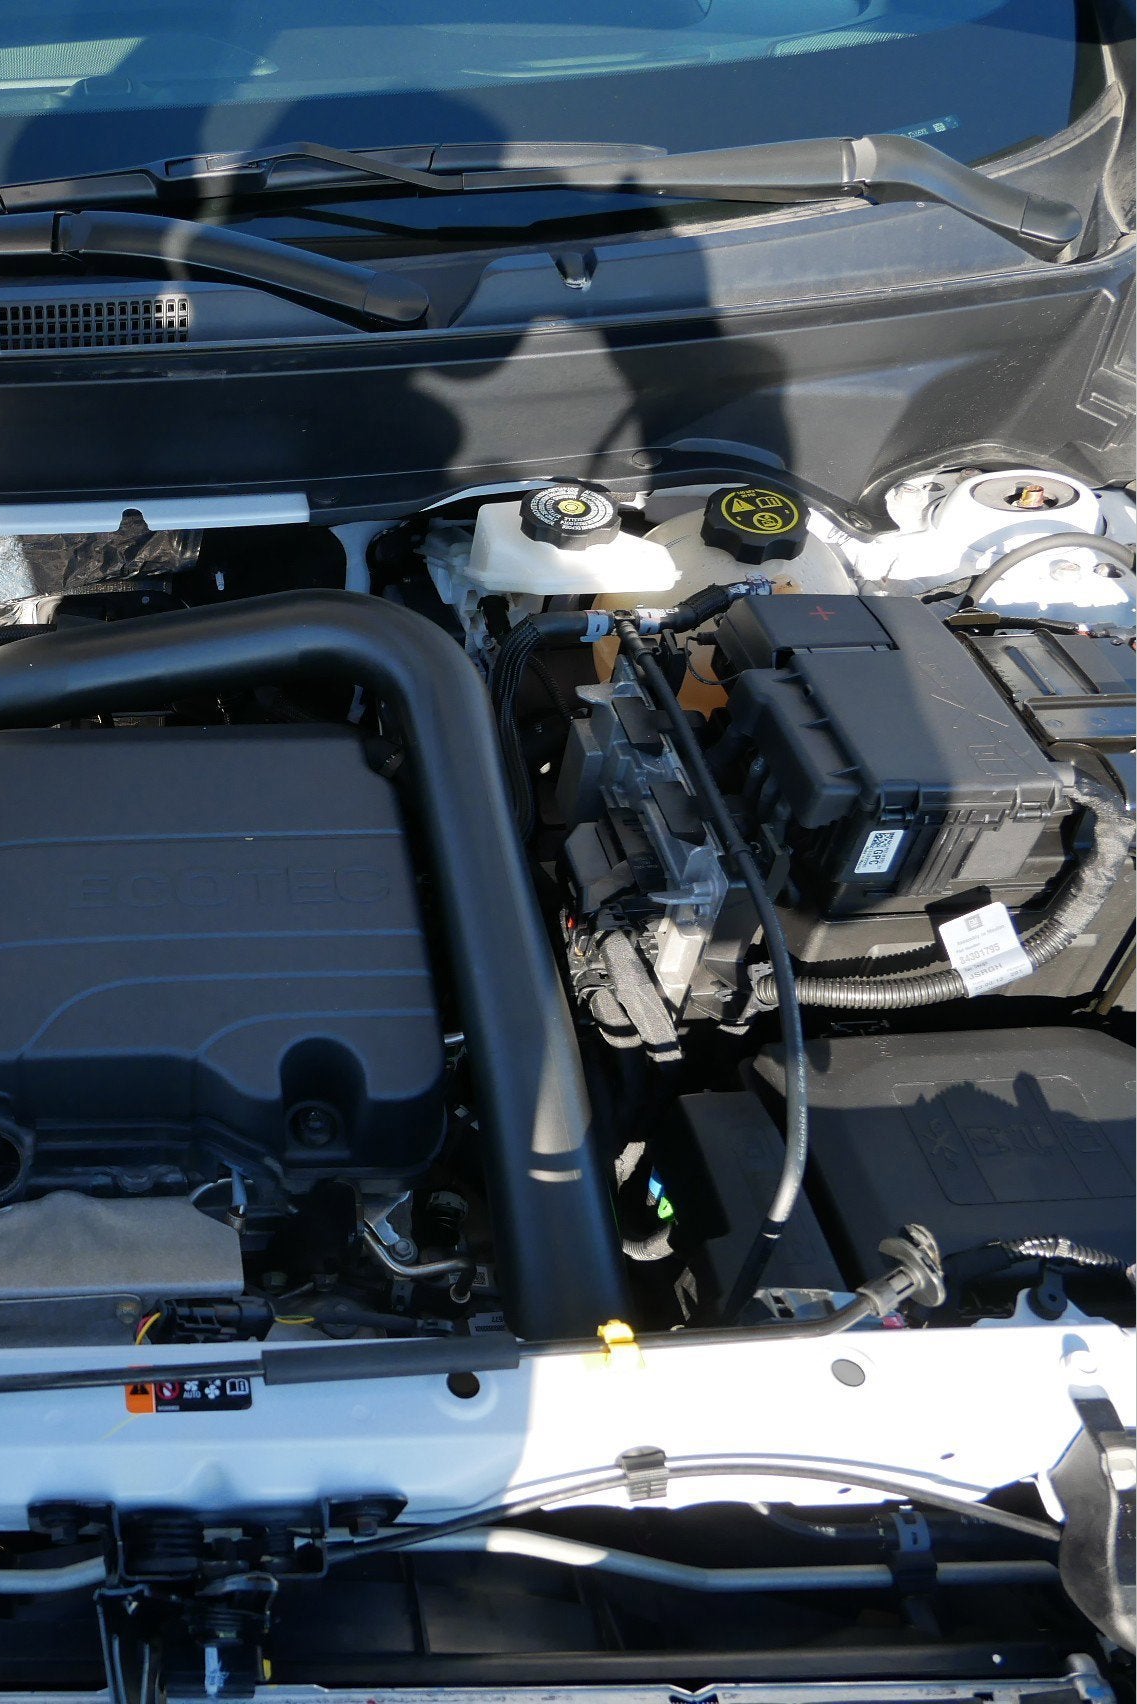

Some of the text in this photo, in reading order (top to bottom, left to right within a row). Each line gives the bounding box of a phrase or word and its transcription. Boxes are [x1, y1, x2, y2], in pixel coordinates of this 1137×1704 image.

[868, 849, 884, 865] GPC
[69, 866, 391, 909] ECOTEC
[183, 1390, 202, 1399] AUTO
